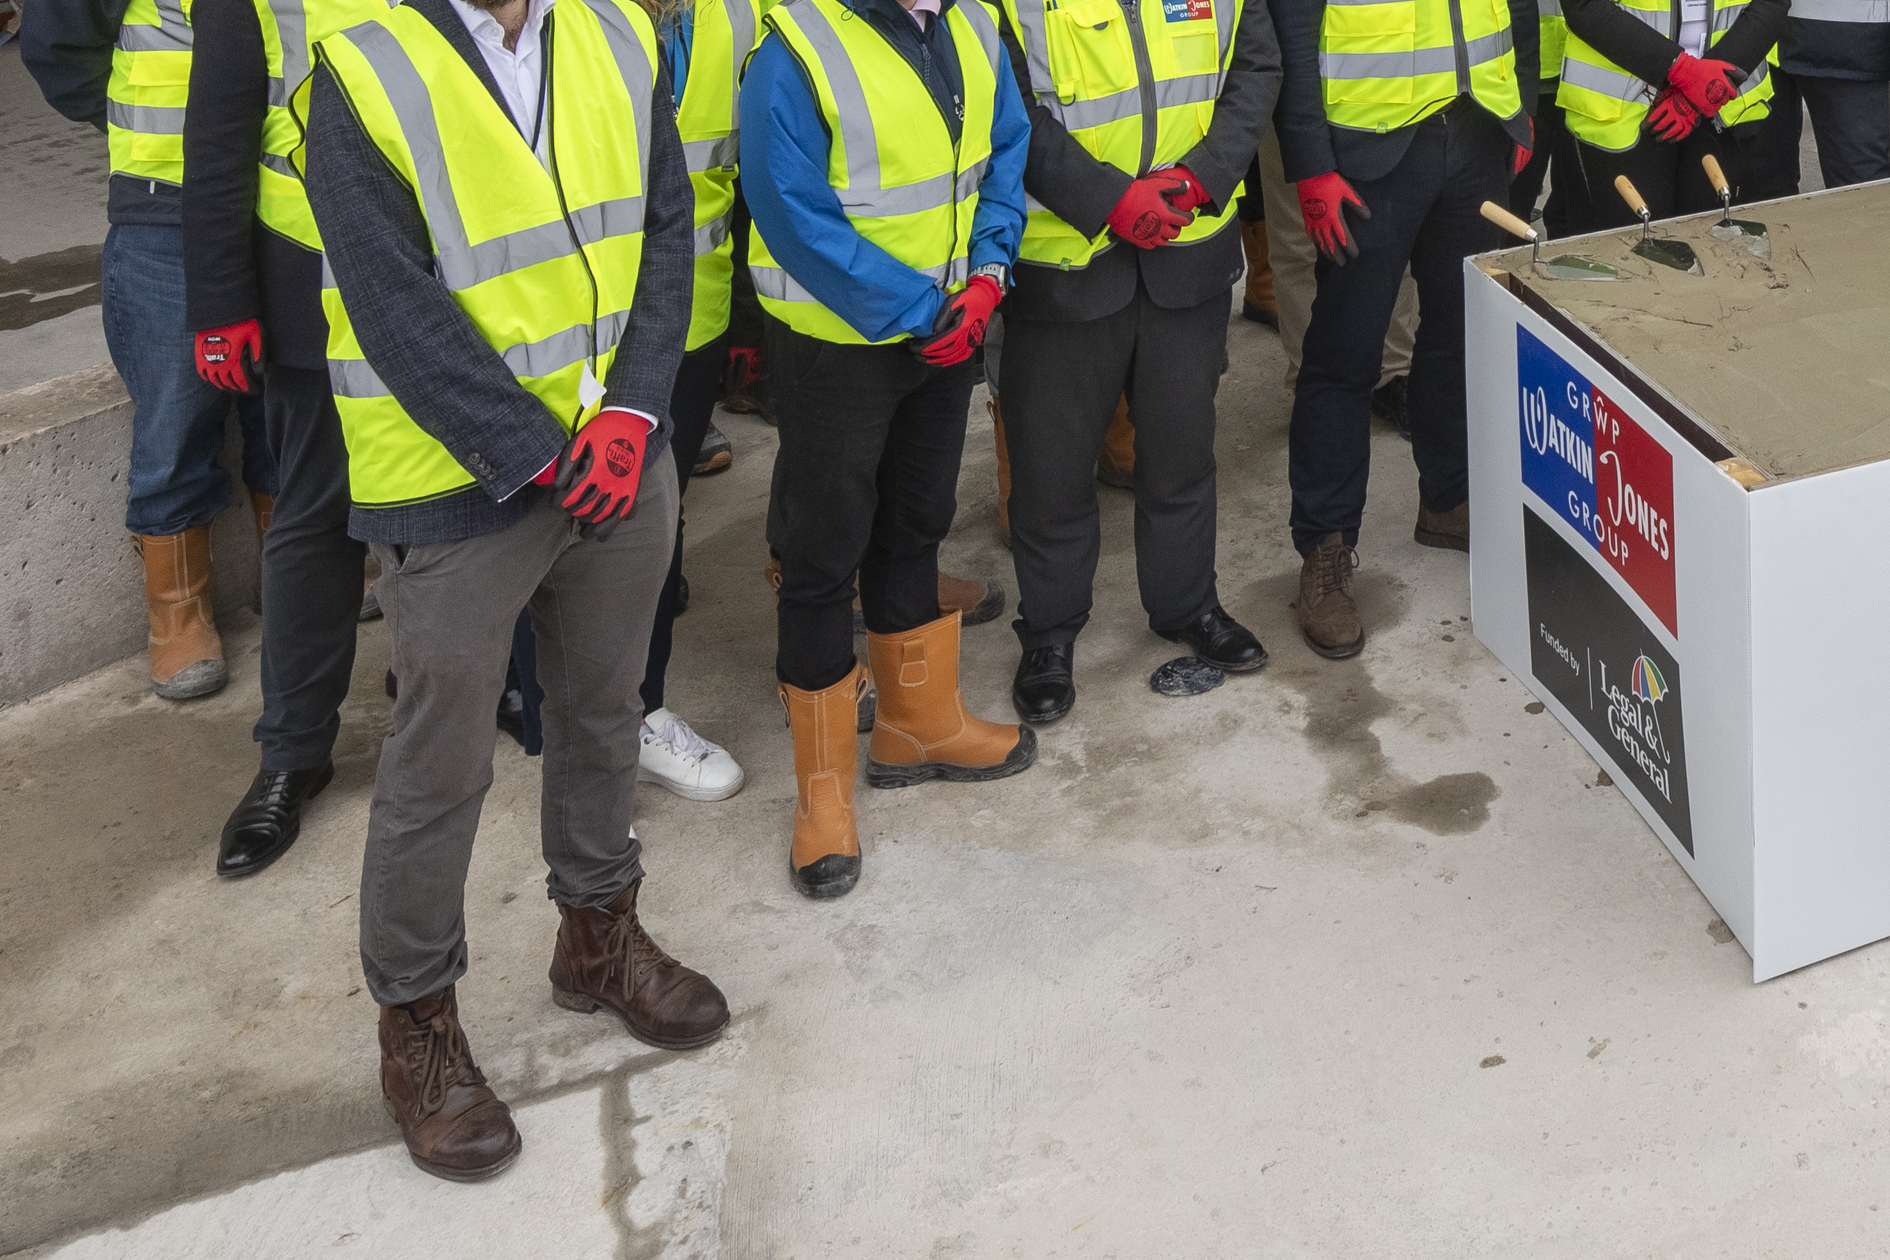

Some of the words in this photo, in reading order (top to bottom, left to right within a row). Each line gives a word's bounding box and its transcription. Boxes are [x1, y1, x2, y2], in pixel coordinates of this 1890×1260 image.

[1164, 0, 1188, 14] WATKIN
[1188, 0, 1210, 12] JONES
[1566, 381, 1621, 445] GRŴP
[1523, 386, 1594, 485] WATKIN
[1600, 451, 1669, 561] JONES
[1568, 491, 1629, 567] GROUP
[1540, 622, 1569, 663] Funded
[1569, 651, 1580, 676] by
[1599, 660, 1644, 738] Legal
[1644, 714, 1661, 760] &
[1607, 705, 1673, 805] General
